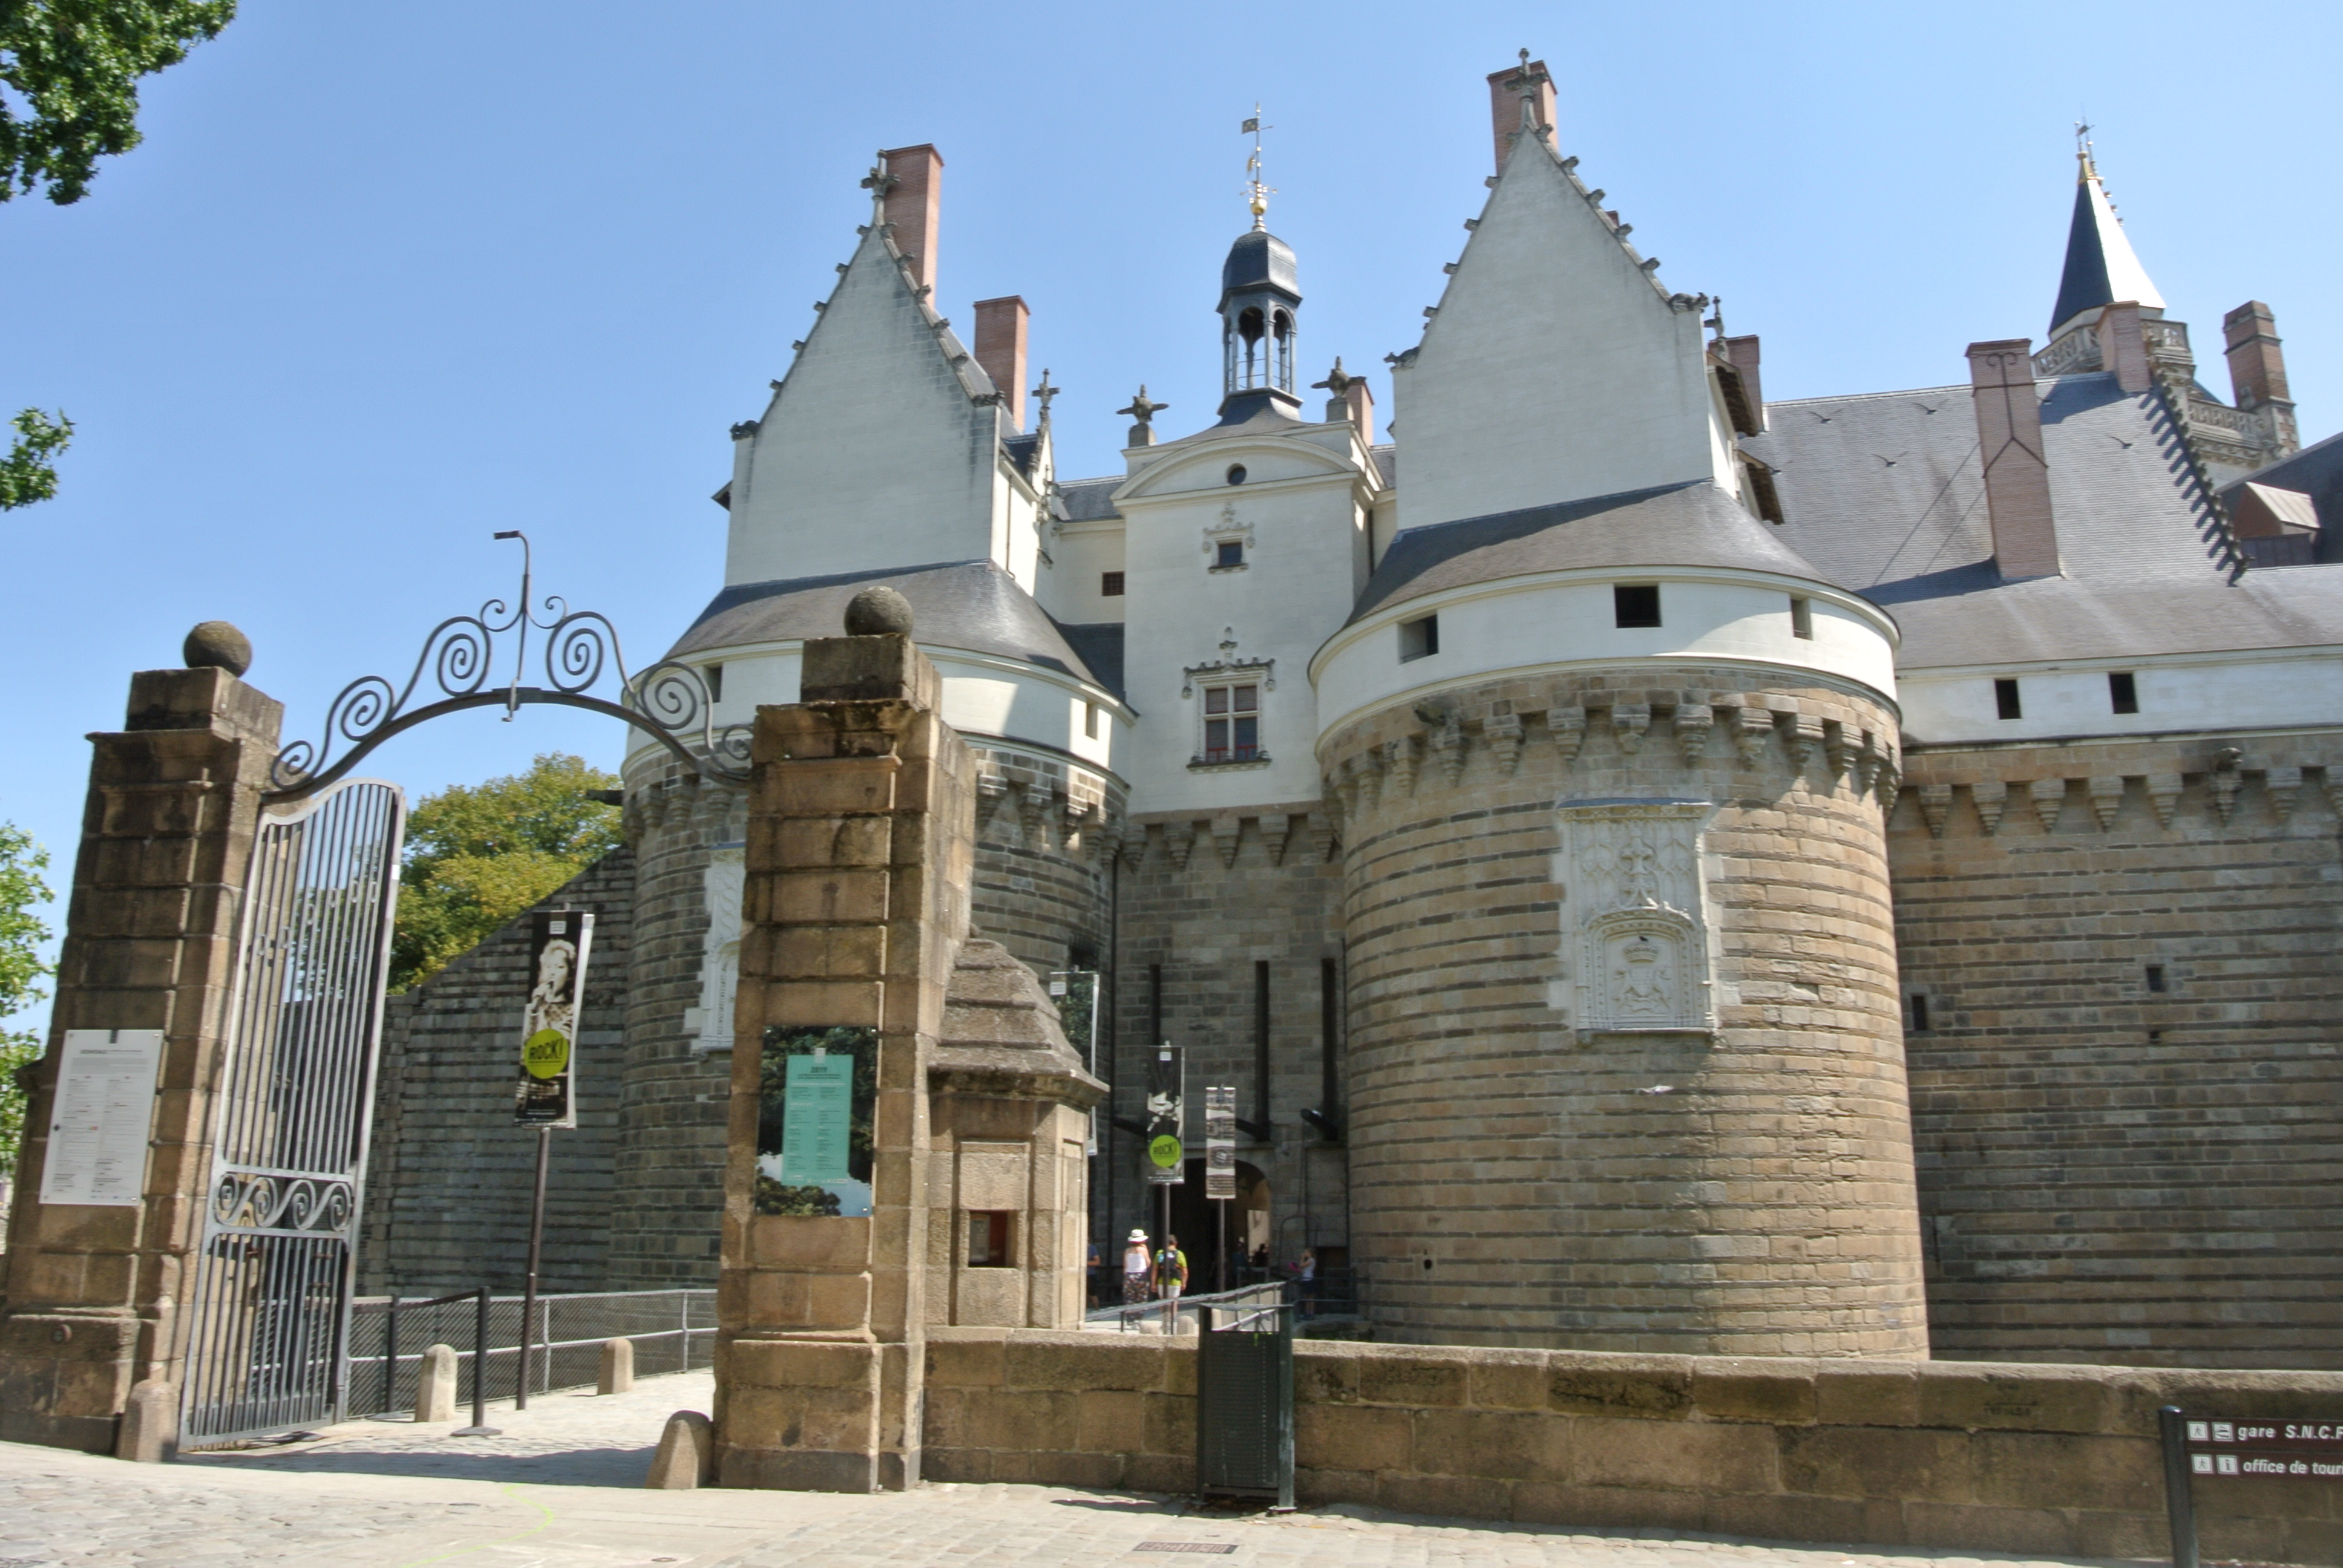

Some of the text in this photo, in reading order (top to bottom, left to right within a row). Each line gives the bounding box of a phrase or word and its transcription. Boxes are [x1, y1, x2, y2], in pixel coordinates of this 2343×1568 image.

[2238, 1426, 2276, 1440] gare
[2243, 1459, 2286, 1473] office
[2289, 1460, 2309, 1474] de
